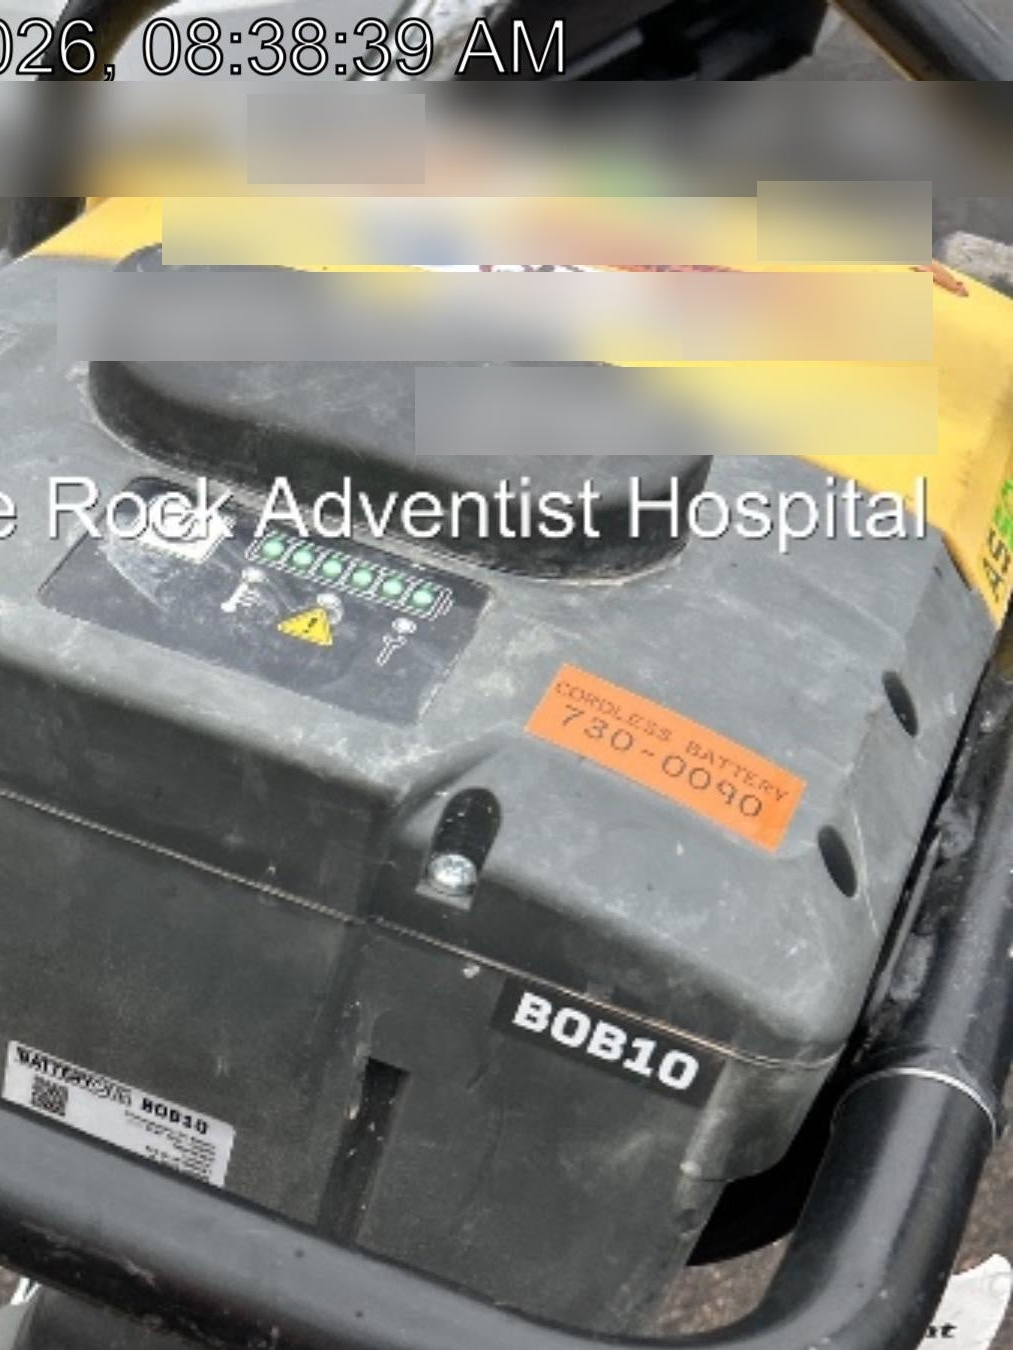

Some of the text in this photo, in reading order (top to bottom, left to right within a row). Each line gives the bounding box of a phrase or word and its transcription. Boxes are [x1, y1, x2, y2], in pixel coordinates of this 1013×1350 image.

[555, 681, 788, 803] CORDLESS BATTERY
[559, 704, 762, 818] 730-0090
[512, 991, 699, 1090] BOB10
